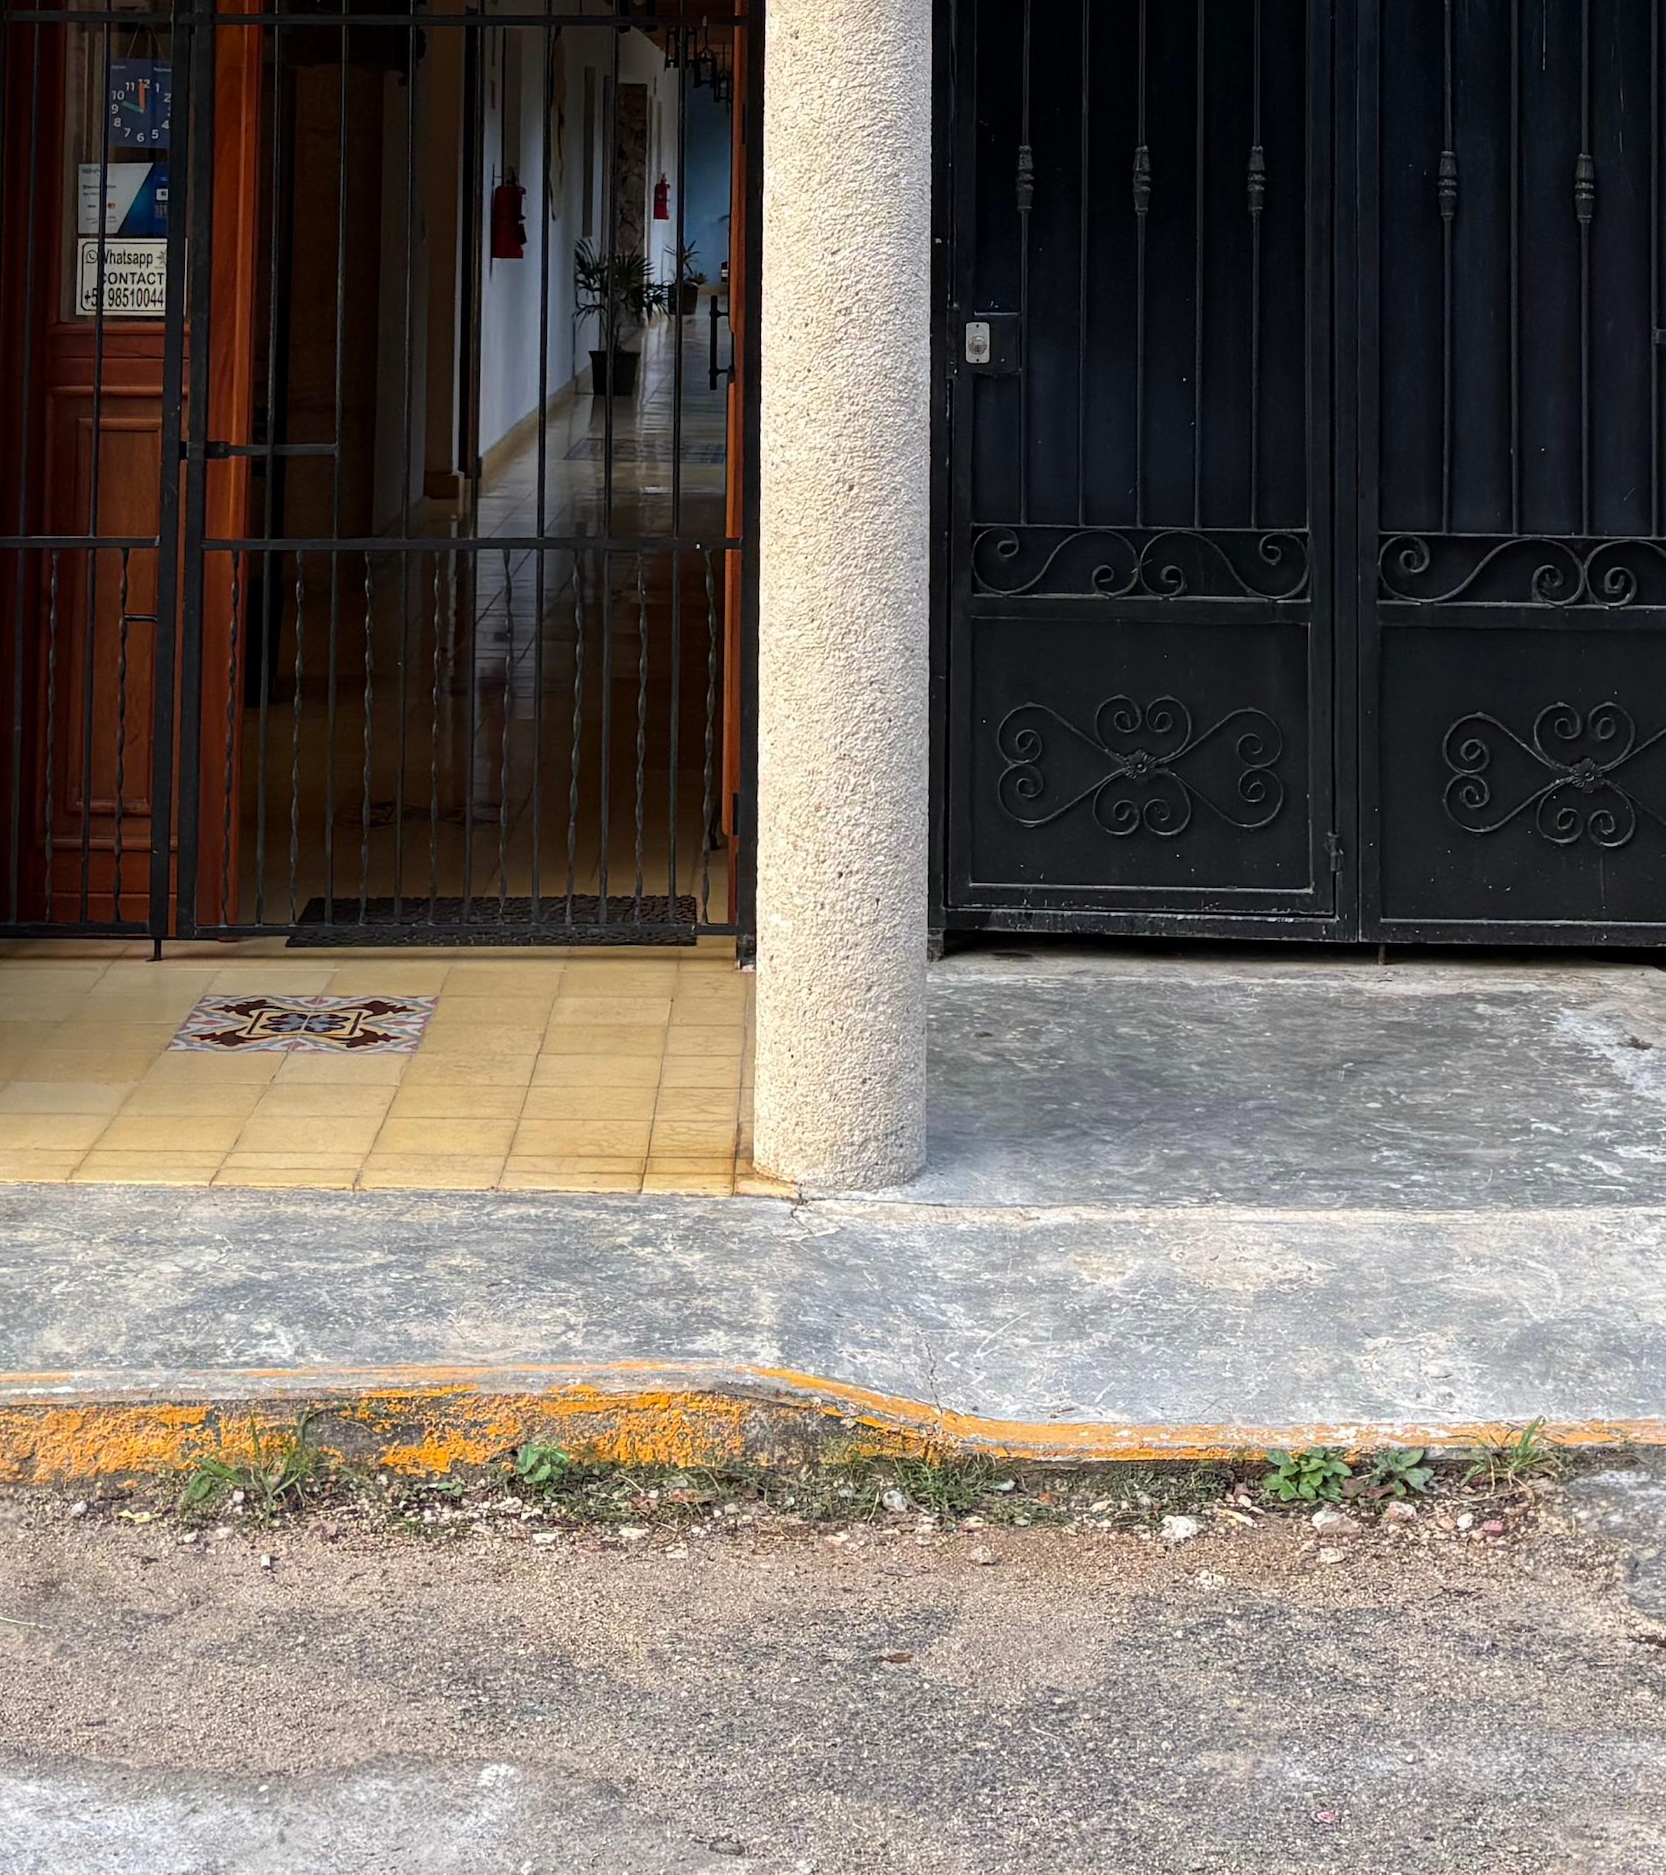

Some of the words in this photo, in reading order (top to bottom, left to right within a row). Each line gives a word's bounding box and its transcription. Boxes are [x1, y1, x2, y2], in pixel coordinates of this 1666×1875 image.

[112, 90, 124, 100] 10
[111, 104, 118, 114] 9
[114, 117, 121, 127] 8
[124, 128, 131, 137] 7
[137, 133, 144, 142] 6
[151, 129, 159, 139] 5
[103, 272, 165, 285] ONTACT
